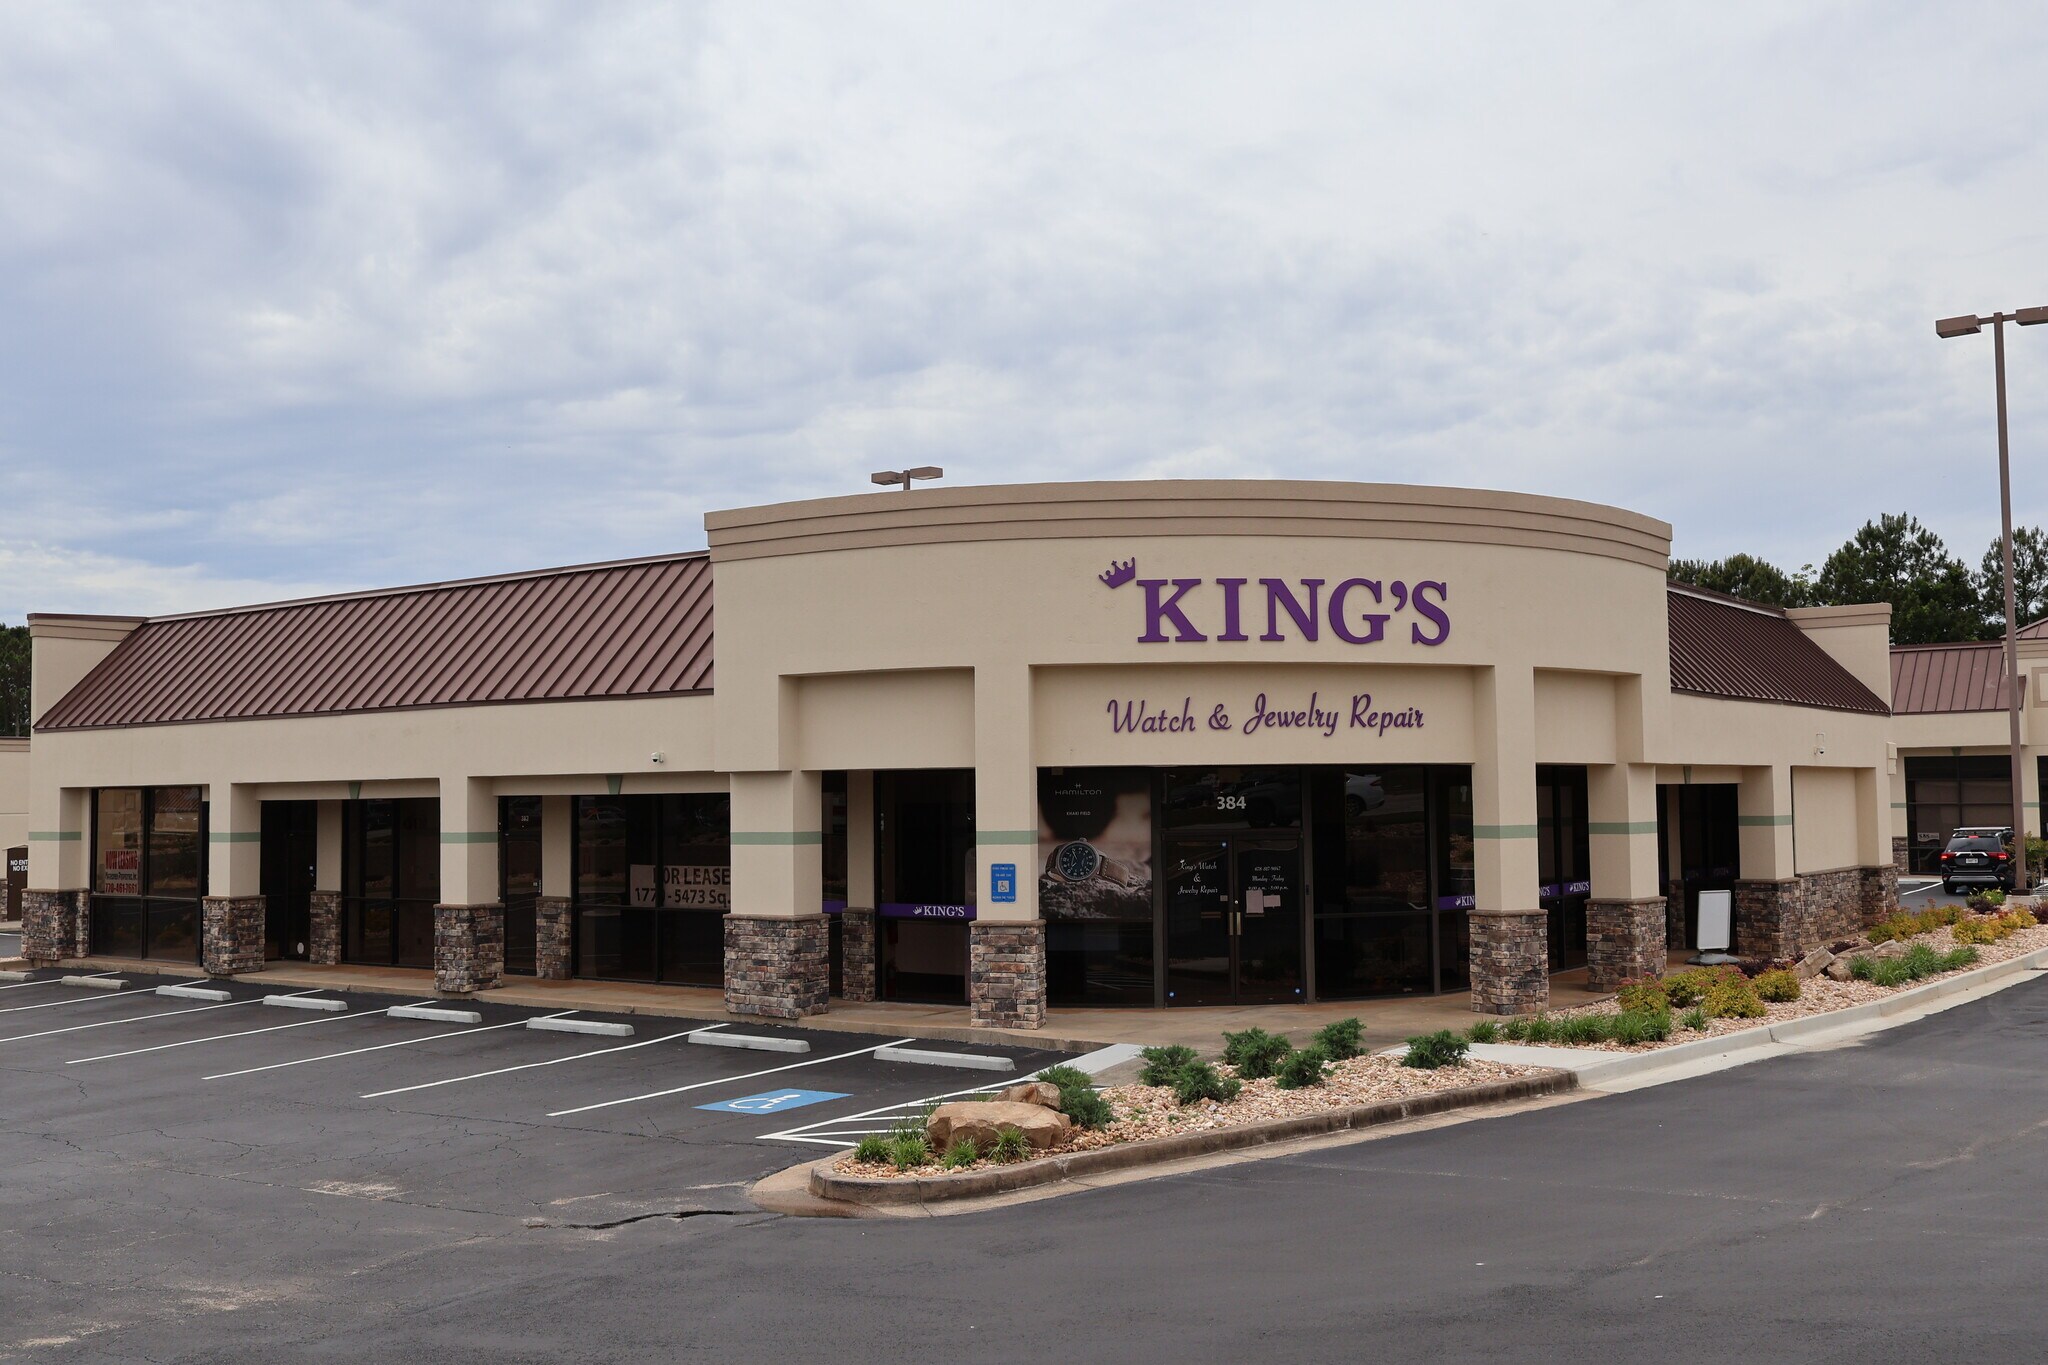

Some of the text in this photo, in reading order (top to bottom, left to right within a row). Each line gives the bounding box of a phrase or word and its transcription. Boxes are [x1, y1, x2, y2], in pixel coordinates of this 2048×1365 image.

[1136, 577, 1451, 646] KING'S
[1106, 691, 1425, 737] Watch & Jewelry Repair
[1217, 796, 1247, 810] 384
[105, 850, 138, 869] NOW LEASING
[1198, 861, 1217, 870] Watch
[684, 868, 731, 885] LEASE
[1193, 873, 1201, 882] &
[635, 888, 666, 902] 177
[674, 889, 706, 904] 5473
[1177, 885, 1218, 895] Jewelry Repair
[923, 905, 965, 917] KING'S
